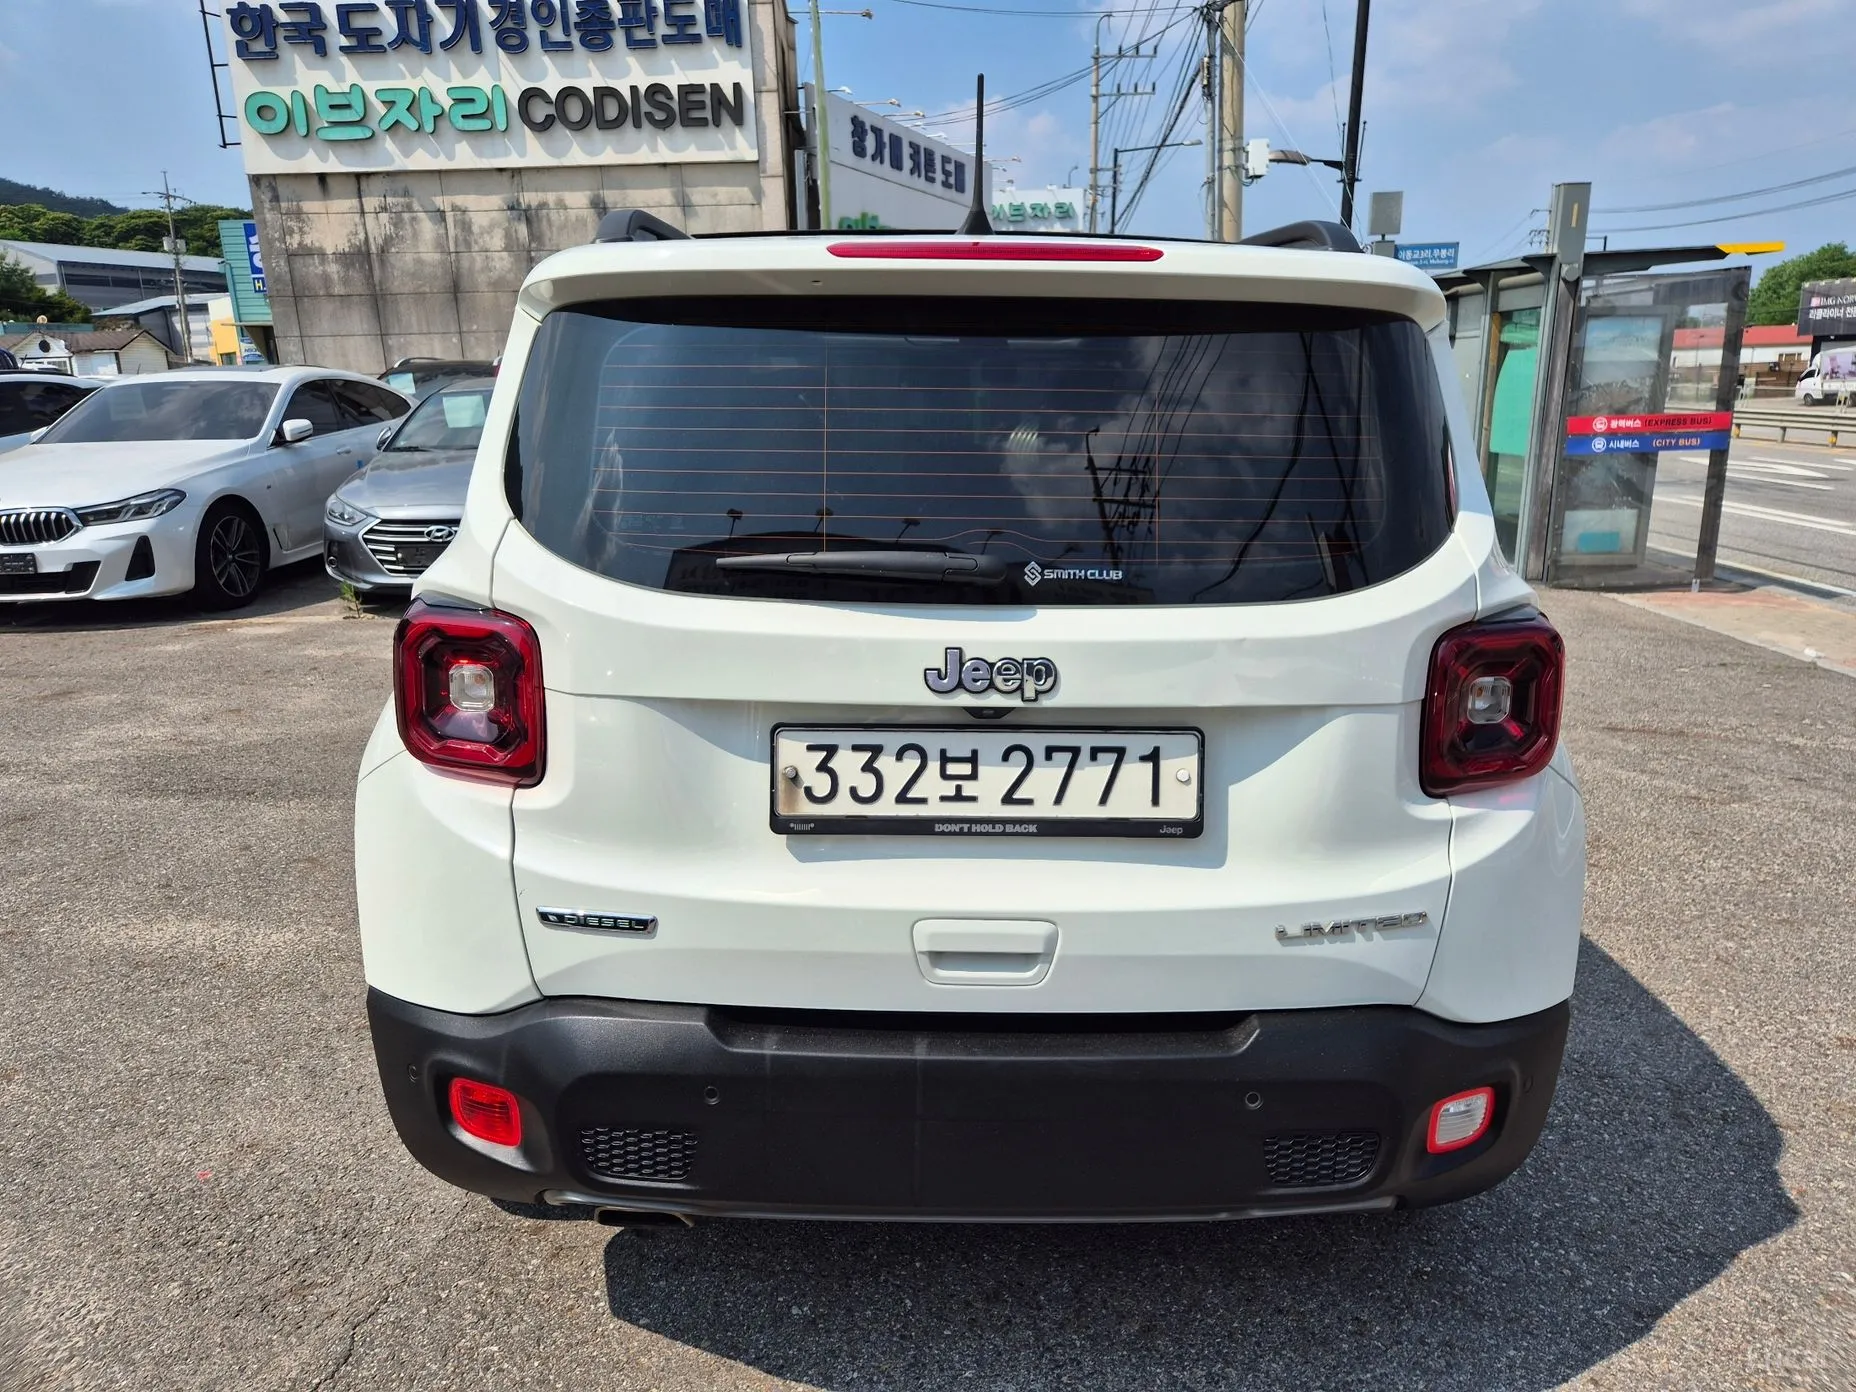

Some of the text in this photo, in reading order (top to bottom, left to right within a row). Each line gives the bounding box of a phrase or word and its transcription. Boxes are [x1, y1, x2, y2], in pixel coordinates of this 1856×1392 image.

[244, 80, 745, 141] 이브자리 CODISEN
[1608, 438, 1701, 449] 시내버스 (CITY BUS)
[1043, 568, 1123, 580] SMITH CLUB
[924, 646, 1058, 702] Jeep
[803, 742, 1162, 807] 332보 2771
[934, 822, 1038, 834] DON'T HOLD BACK
[1159, 824, 1184, 836] Jeep
[564, 913, 645, 929] DIESEL
[1274, 910, 1428, 940] LIMITED
